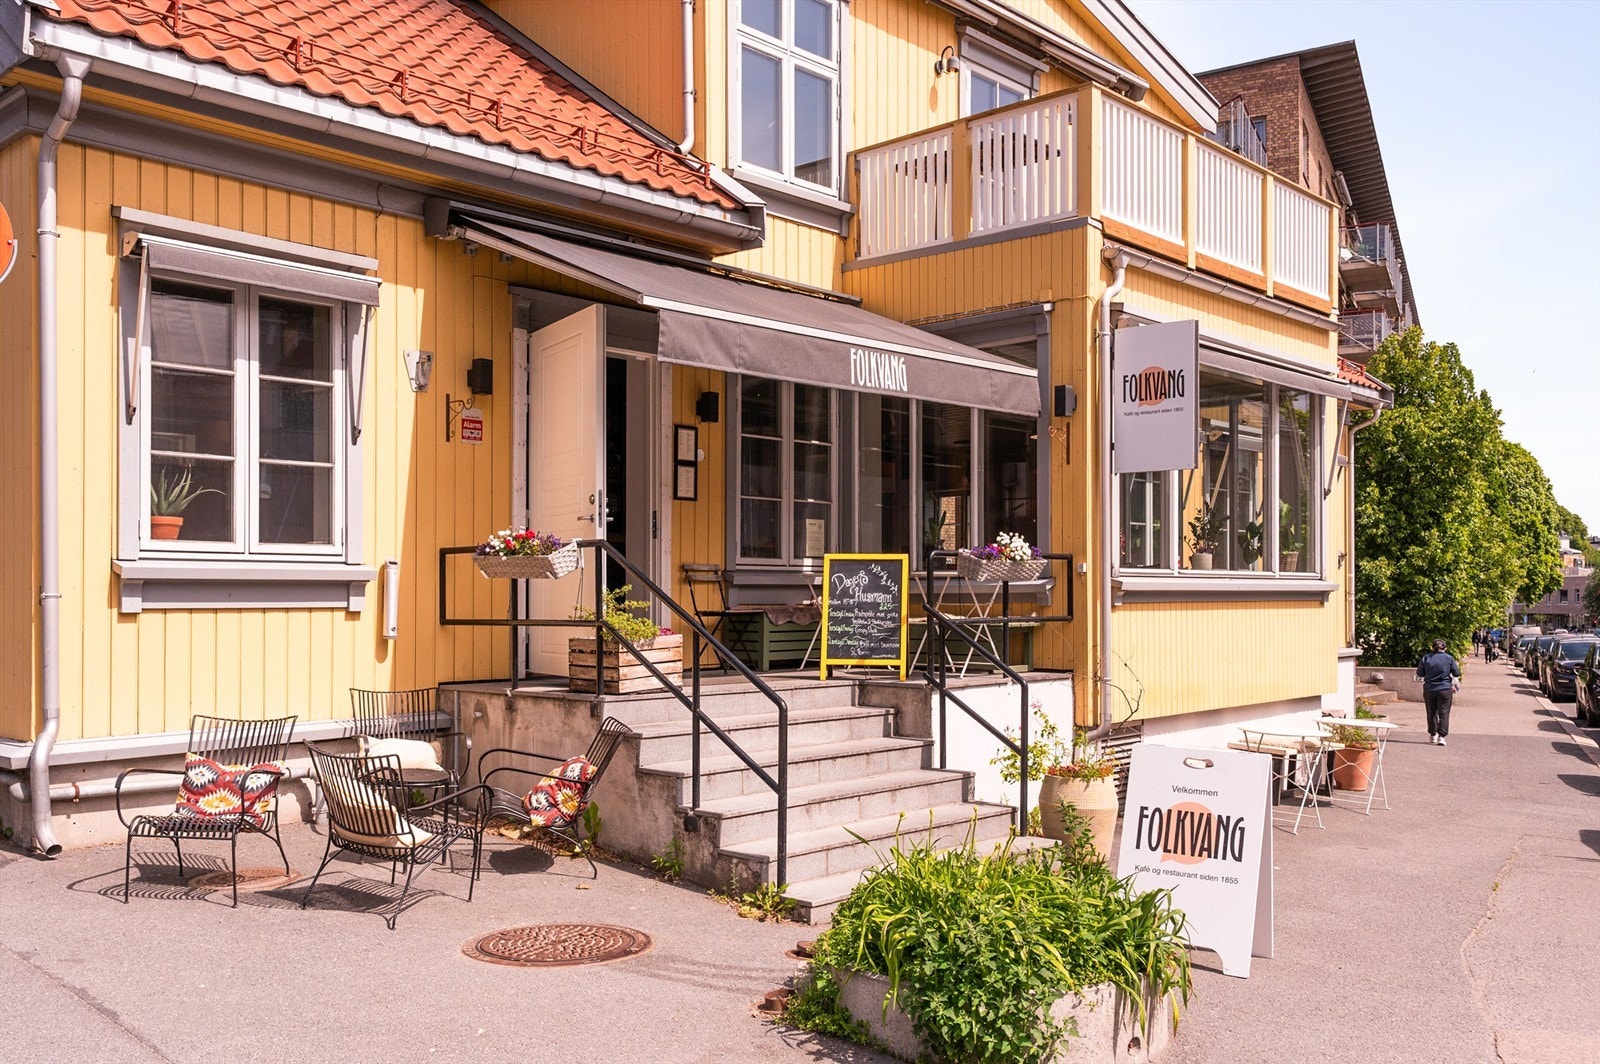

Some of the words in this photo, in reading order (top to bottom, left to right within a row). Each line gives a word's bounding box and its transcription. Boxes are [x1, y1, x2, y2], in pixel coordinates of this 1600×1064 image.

[850, 347, 908, 392] FOLKVANG
[1123, 369, 1185, 403] FOLKVANG
[1171, 784, 1219, 797] Velkommen
[1135, 805, 1246, 863] FOLKVANG
[1134, 864, 1151, 873] Kafé
[1151, 867, 1161, 875] og
[1162, 868, 1198, 879] restaurant
[1199, 872, 1219, 882] siden
[1220, 876, 1239, 885] 1855
